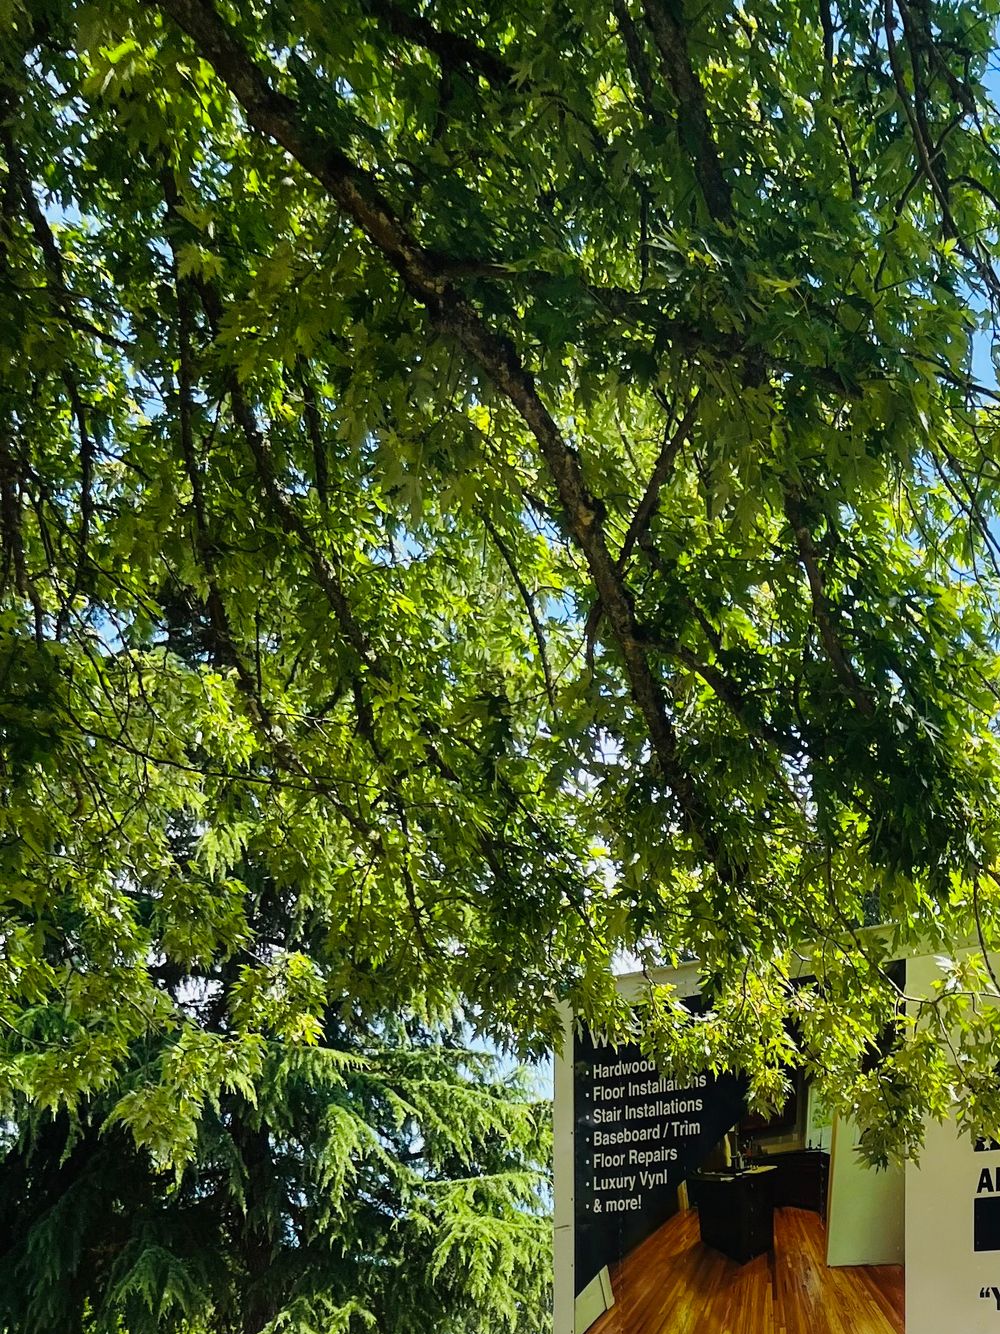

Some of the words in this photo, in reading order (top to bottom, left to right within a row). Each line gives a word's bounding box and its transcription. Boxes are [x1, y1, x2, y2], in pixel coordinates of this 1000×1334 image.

[593, 1060, 656, 1079] Hardwood
[593, 1086, 626, 1101] Floor
[628, 1074, 707, 1096] Installans
[593, 1106, 622, 1124] Stair
[625, 1098, 703, 1120] Installations
[593, 1124, 660, 1146] Baseboard
[671, 1120, 701, 1137] Trim
[593, 1153, 626, 1168] Floor
[628, 1146, 678, 1167] Repairs
[593, 1175, 636, 1191] Luxury
[639, 1169, 668, 1189] Vynl
[593, 1198, 602, 1213] &
[605, 1194, 642, 1212] more!
